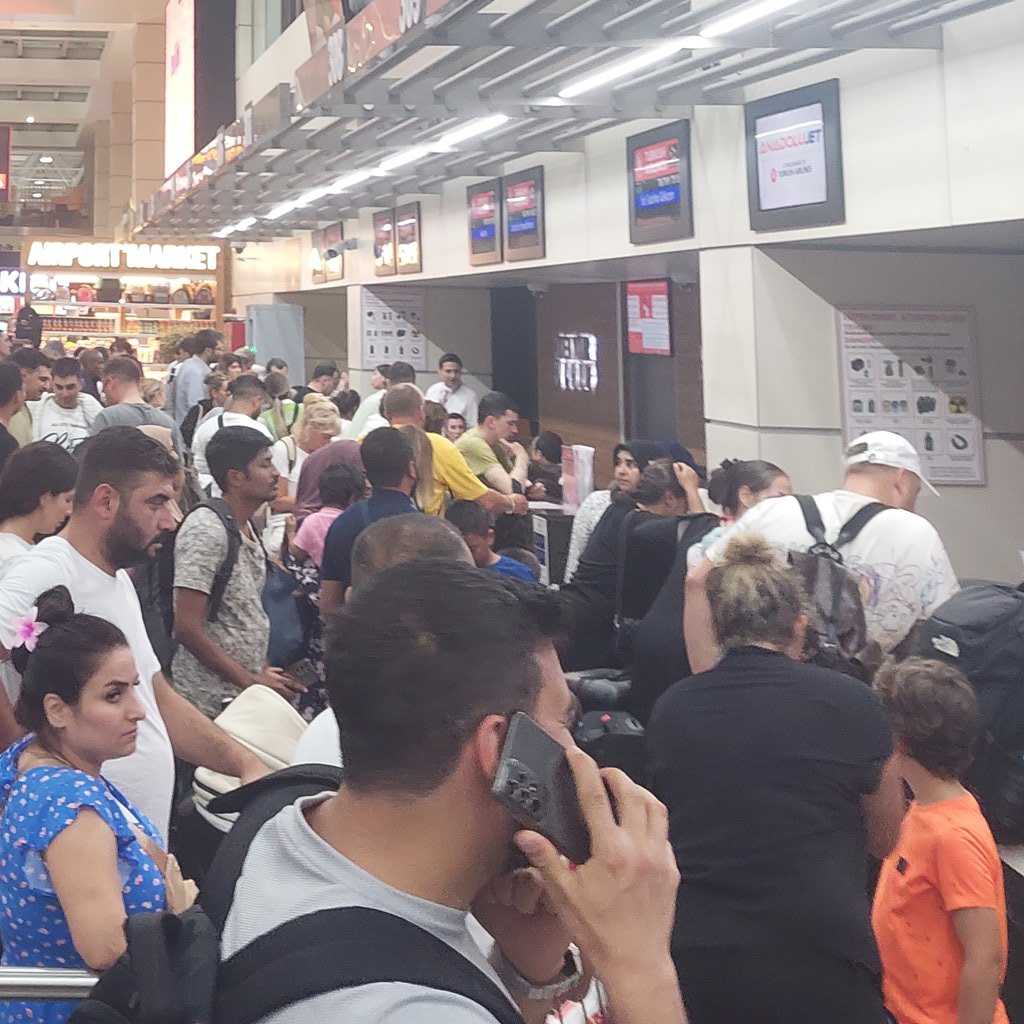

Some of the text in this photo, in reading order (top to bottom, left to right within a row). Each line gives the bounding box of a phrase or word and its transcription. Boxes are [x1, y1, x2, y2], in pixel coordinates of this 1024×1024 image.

[27, 241, 221, 270] AIRPORT MARKET
[0, 270, 26, 293] KI
